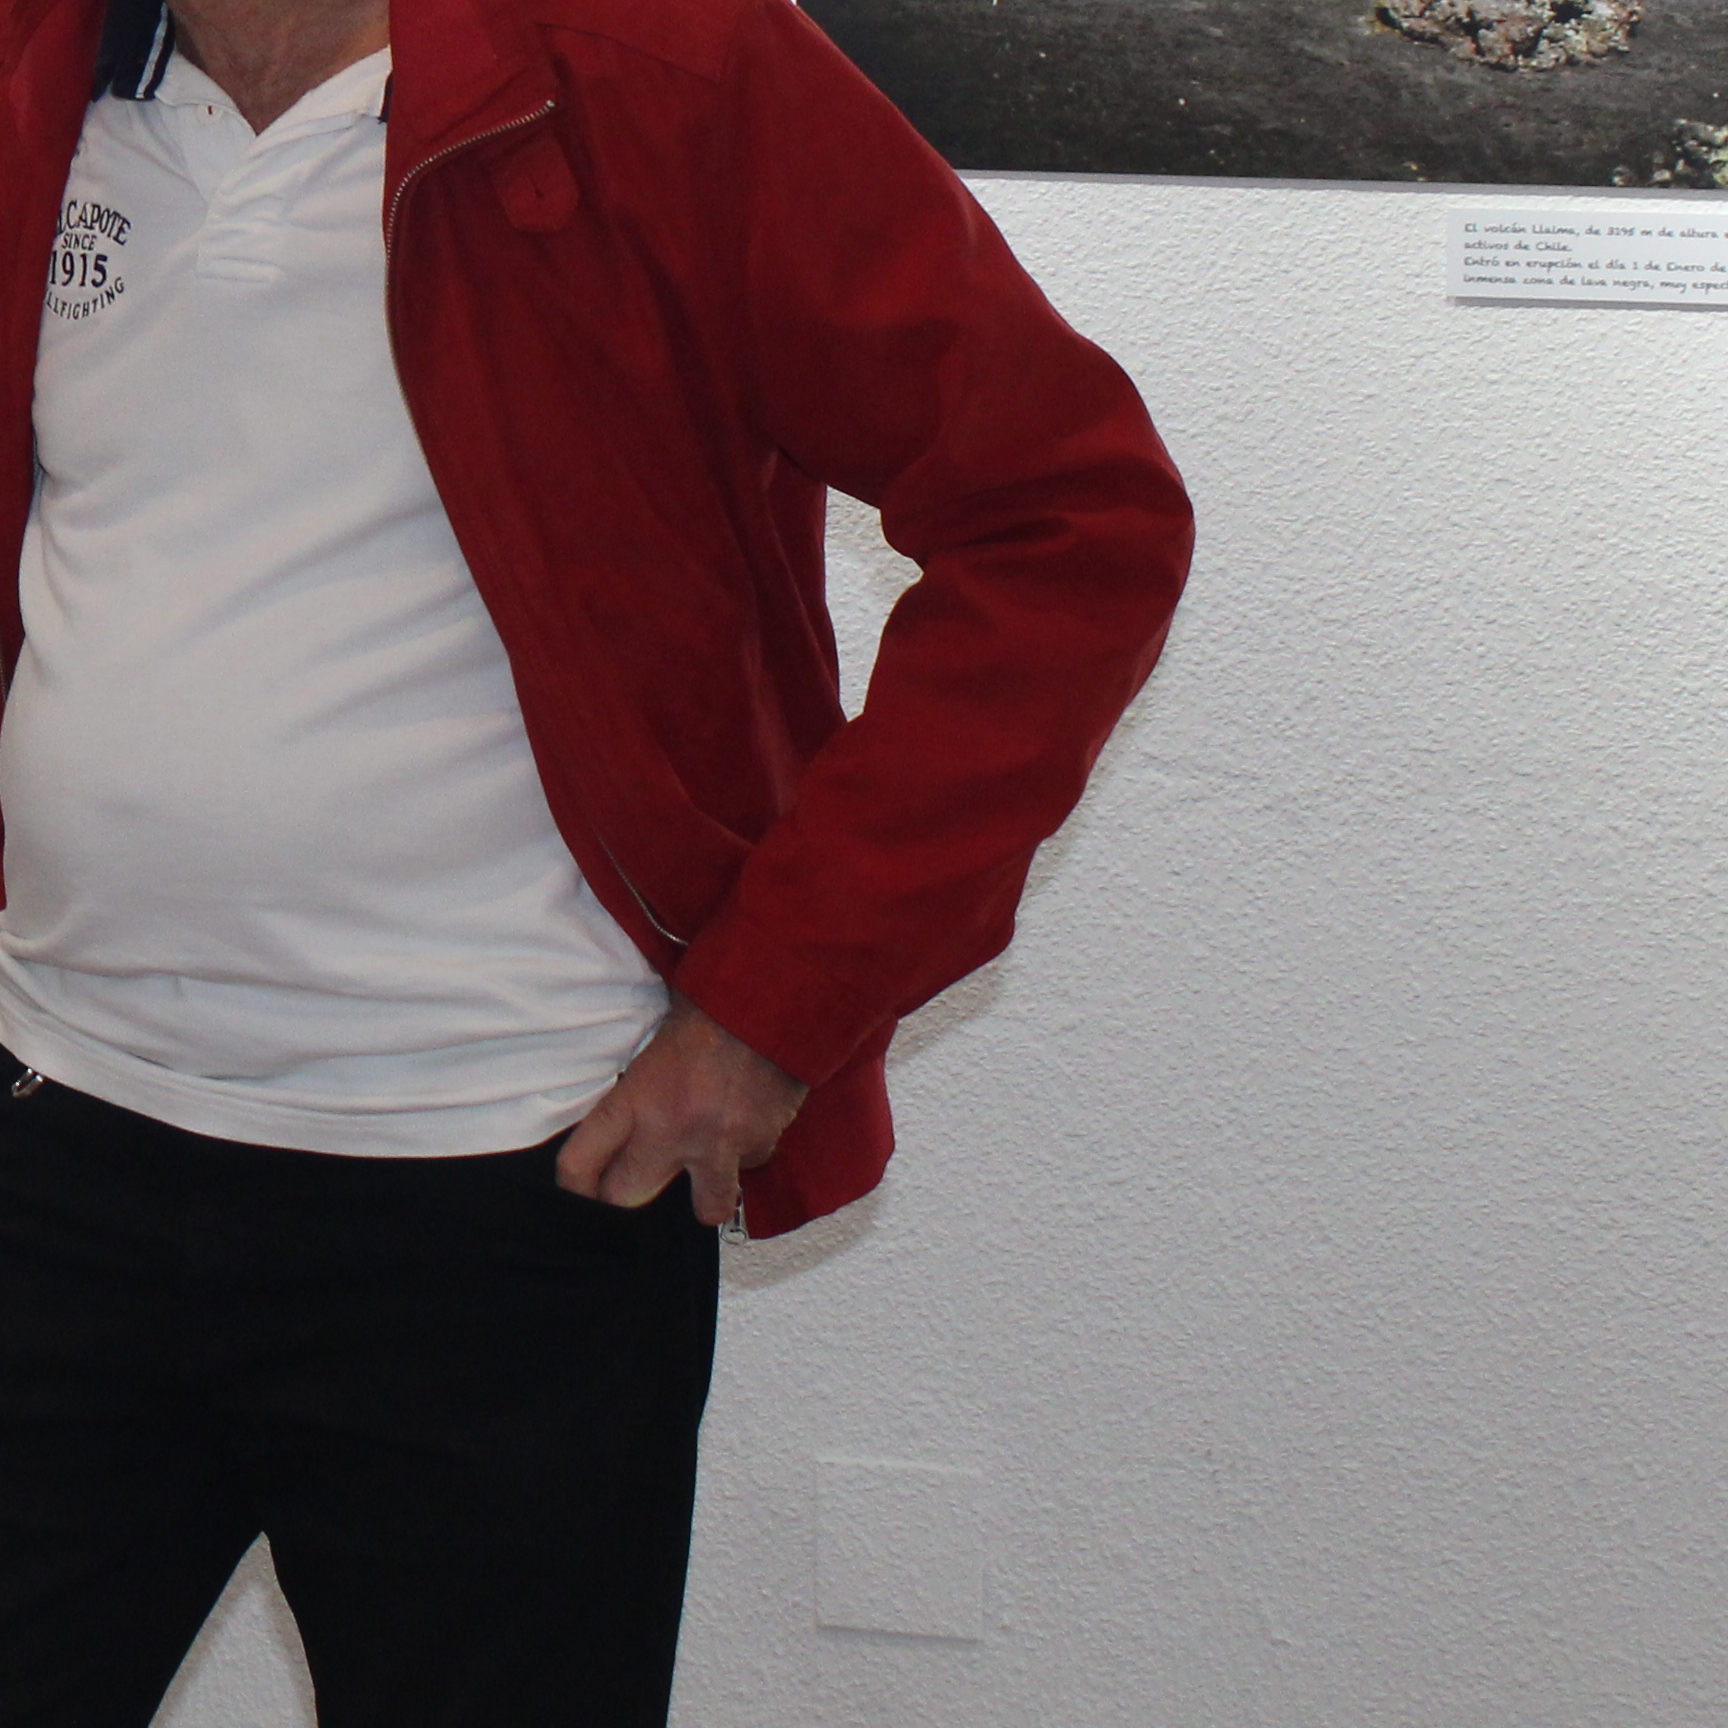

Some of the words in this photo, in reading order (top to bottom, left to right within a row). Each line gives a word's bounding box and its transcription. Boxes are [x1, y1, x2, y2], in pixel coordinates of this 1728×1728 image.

[67, 199, 131, 246] CAPOTE
[1465, 223, 1477, 232] El
[1484, 222, 1526, 233] volcán
[1532, 224, 1580, 236] Llaima,
[1585, 225, 1600, 235] de
[1658, 227, 1673, 237] de
[1680, 227, 1717, 238] altura
[62, 233, 97, 250] SINCE
[1464, 240, 1508, 250] activos
[1514, 240, 1530, 250] de
[1536, 241, 1572, 251] Chile.
[50, 250, 107, 287] 1915
[1464, 256, 1499, 266] Entró
[1526, 257, 1582, 272] erupción
[1588, 259, 1600, 269] el
[1606, 259, 1625, 269] día
[1645, 261, 1660, 271] de
[1667, 262, 1705, 271] Enero
[1710, 262, 1726, 272] de
[1560, 275, 1575, 285] de
[1613, 280, 1654, 291] negra,
[1659, 281, 1686, 293] muy
[46, 277, 124, 319] LLFIGHTING
